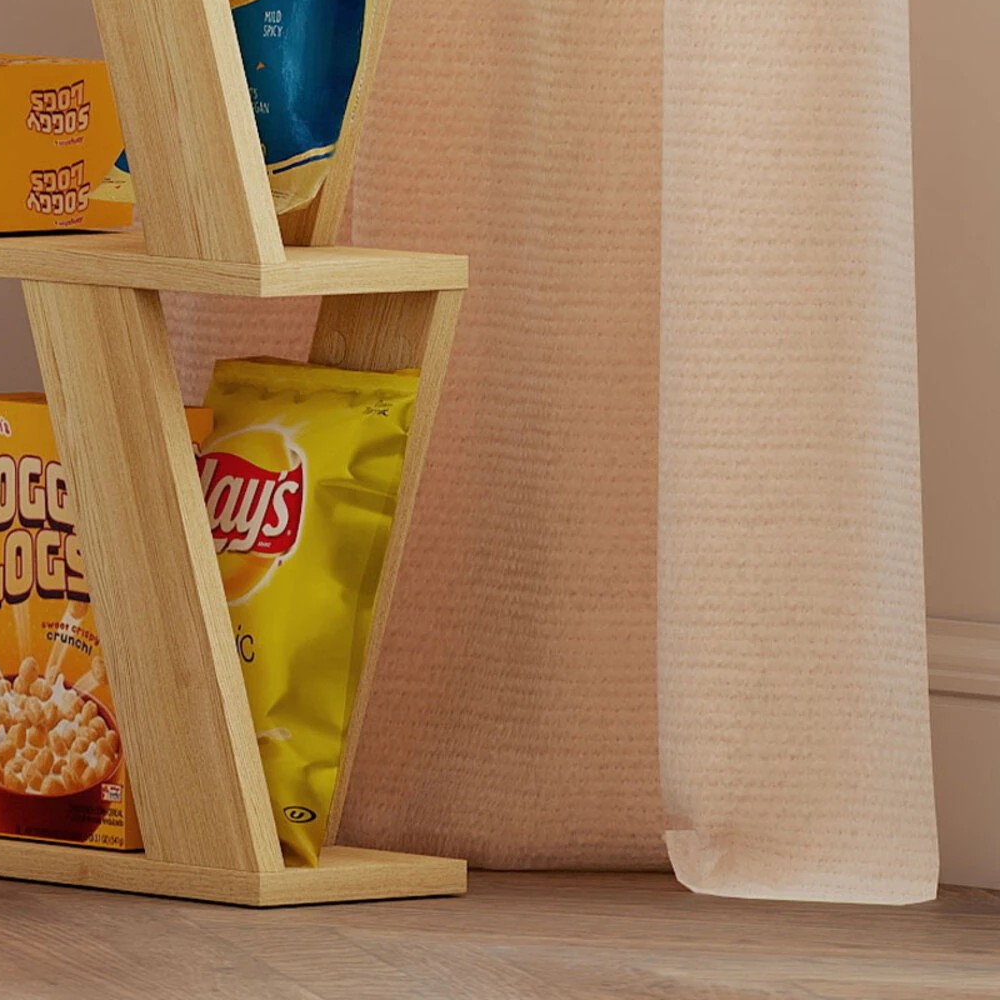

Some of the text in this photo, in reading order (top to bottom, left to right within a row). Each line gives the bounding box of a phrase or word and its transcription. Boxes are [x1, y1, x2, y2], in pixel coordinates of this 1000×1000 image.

[264, 10, 282, 23] MILD
[263, 24, 283, 37] SPICY
[30, 80, 85, 112] LOGS
[26, 102, 91, 135] SOGGY
[250, 101, 270, 114] GAN
[30, 160, 85, 192] LOGS
[26, 182, 91, 215] SOGGY
[41, 621, 69, 631] sweet
